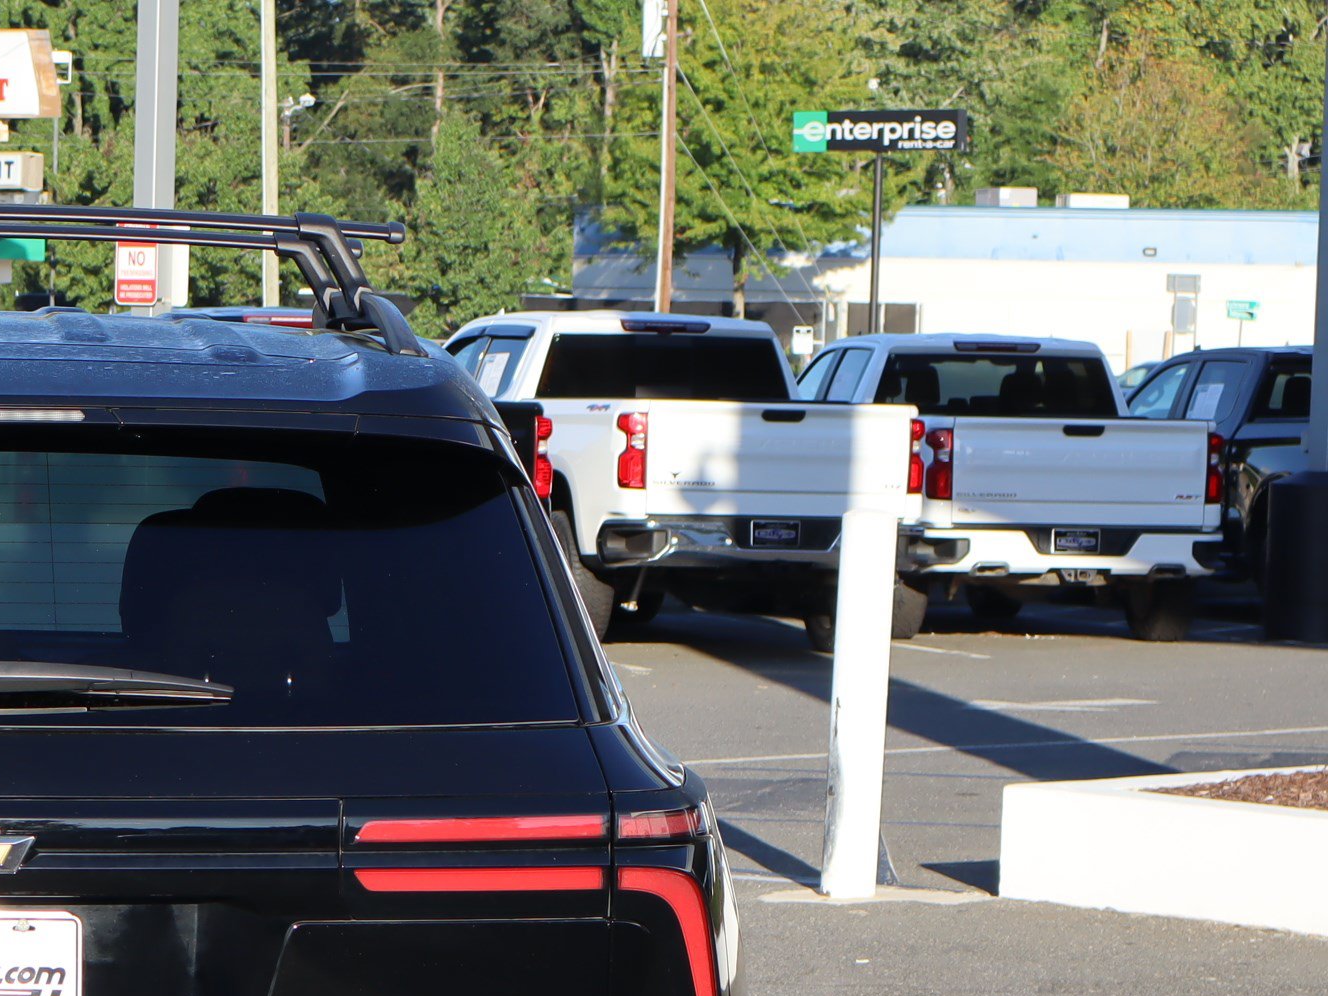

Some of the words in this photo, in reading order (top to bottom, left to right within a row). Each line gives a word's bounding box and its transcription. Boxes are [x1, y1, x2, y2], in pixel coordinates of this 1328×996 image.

[793, 115, 956, 146] enterprise
[898, 140, 955, 149] rent-a-car
[128, 251, 146, 266] NO
